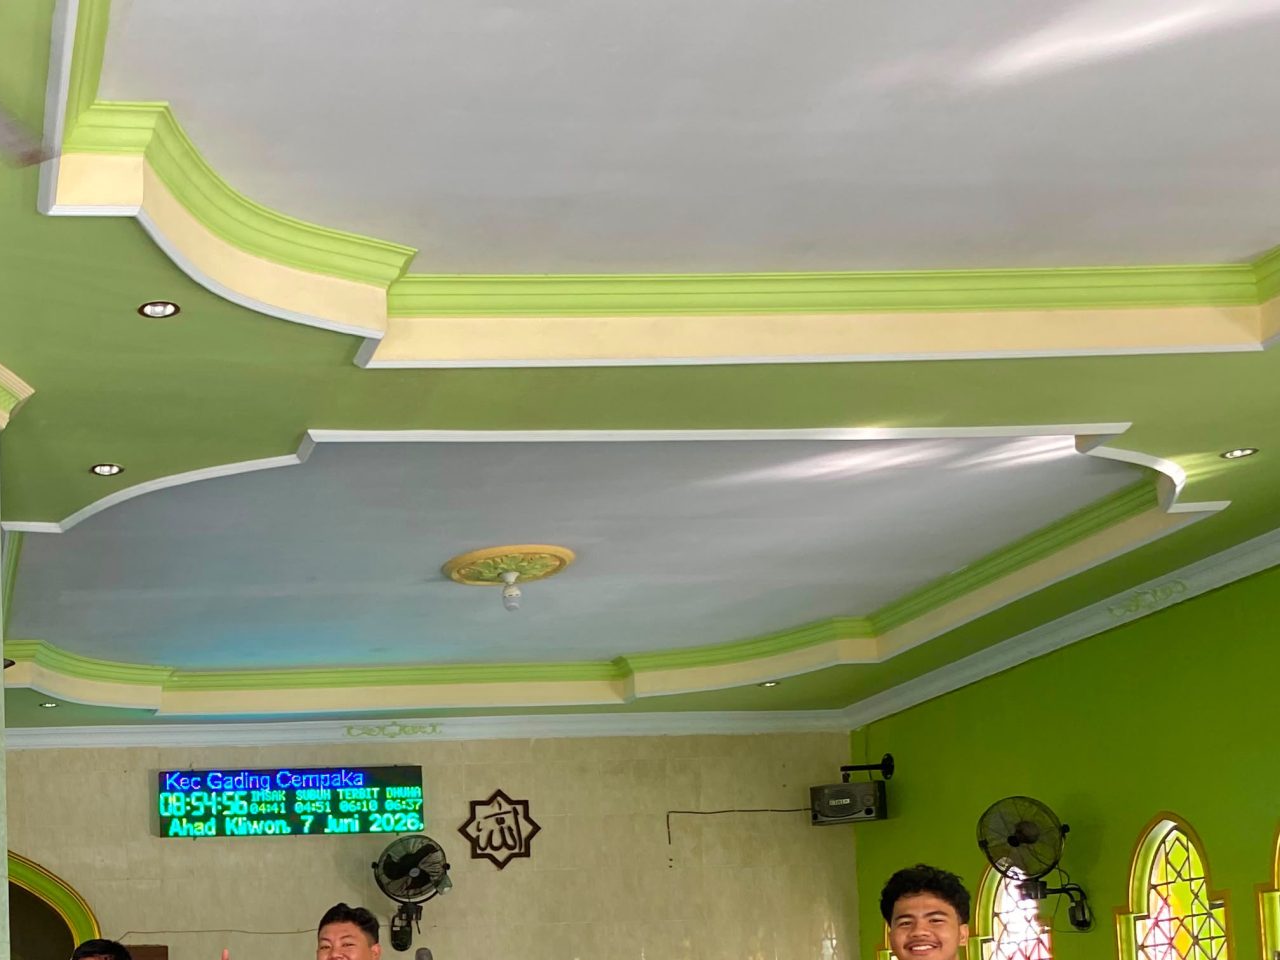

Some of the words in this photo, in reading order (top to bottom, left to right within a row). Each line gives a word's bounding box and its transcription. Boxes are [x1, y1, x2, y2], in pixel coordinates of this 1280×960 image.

[165, 772, 201, 790] Kec
[207, 771, 270, 791] Gading
[276, 769, 363, 792] Cempaka
[160, 791, 248, 816] 08:54:56
[250, 790, 286, 801] IMSAK
[295, 789, 331, 801] SUBUH
[337, 788, 380, 800] TERBIT
[386, 786, 421, 798] DHUHA
[250, 802, 286, 814] 04:41
[295, 801, 331, 813] 04:51
[339, 800, 378, 812] 06:10
[384, 799, 422, 811] 06:37
[169, 817, 217, 836] Ahad
[300, 815, 314, 833] 7
[324, 813, 360, 833] Juni
